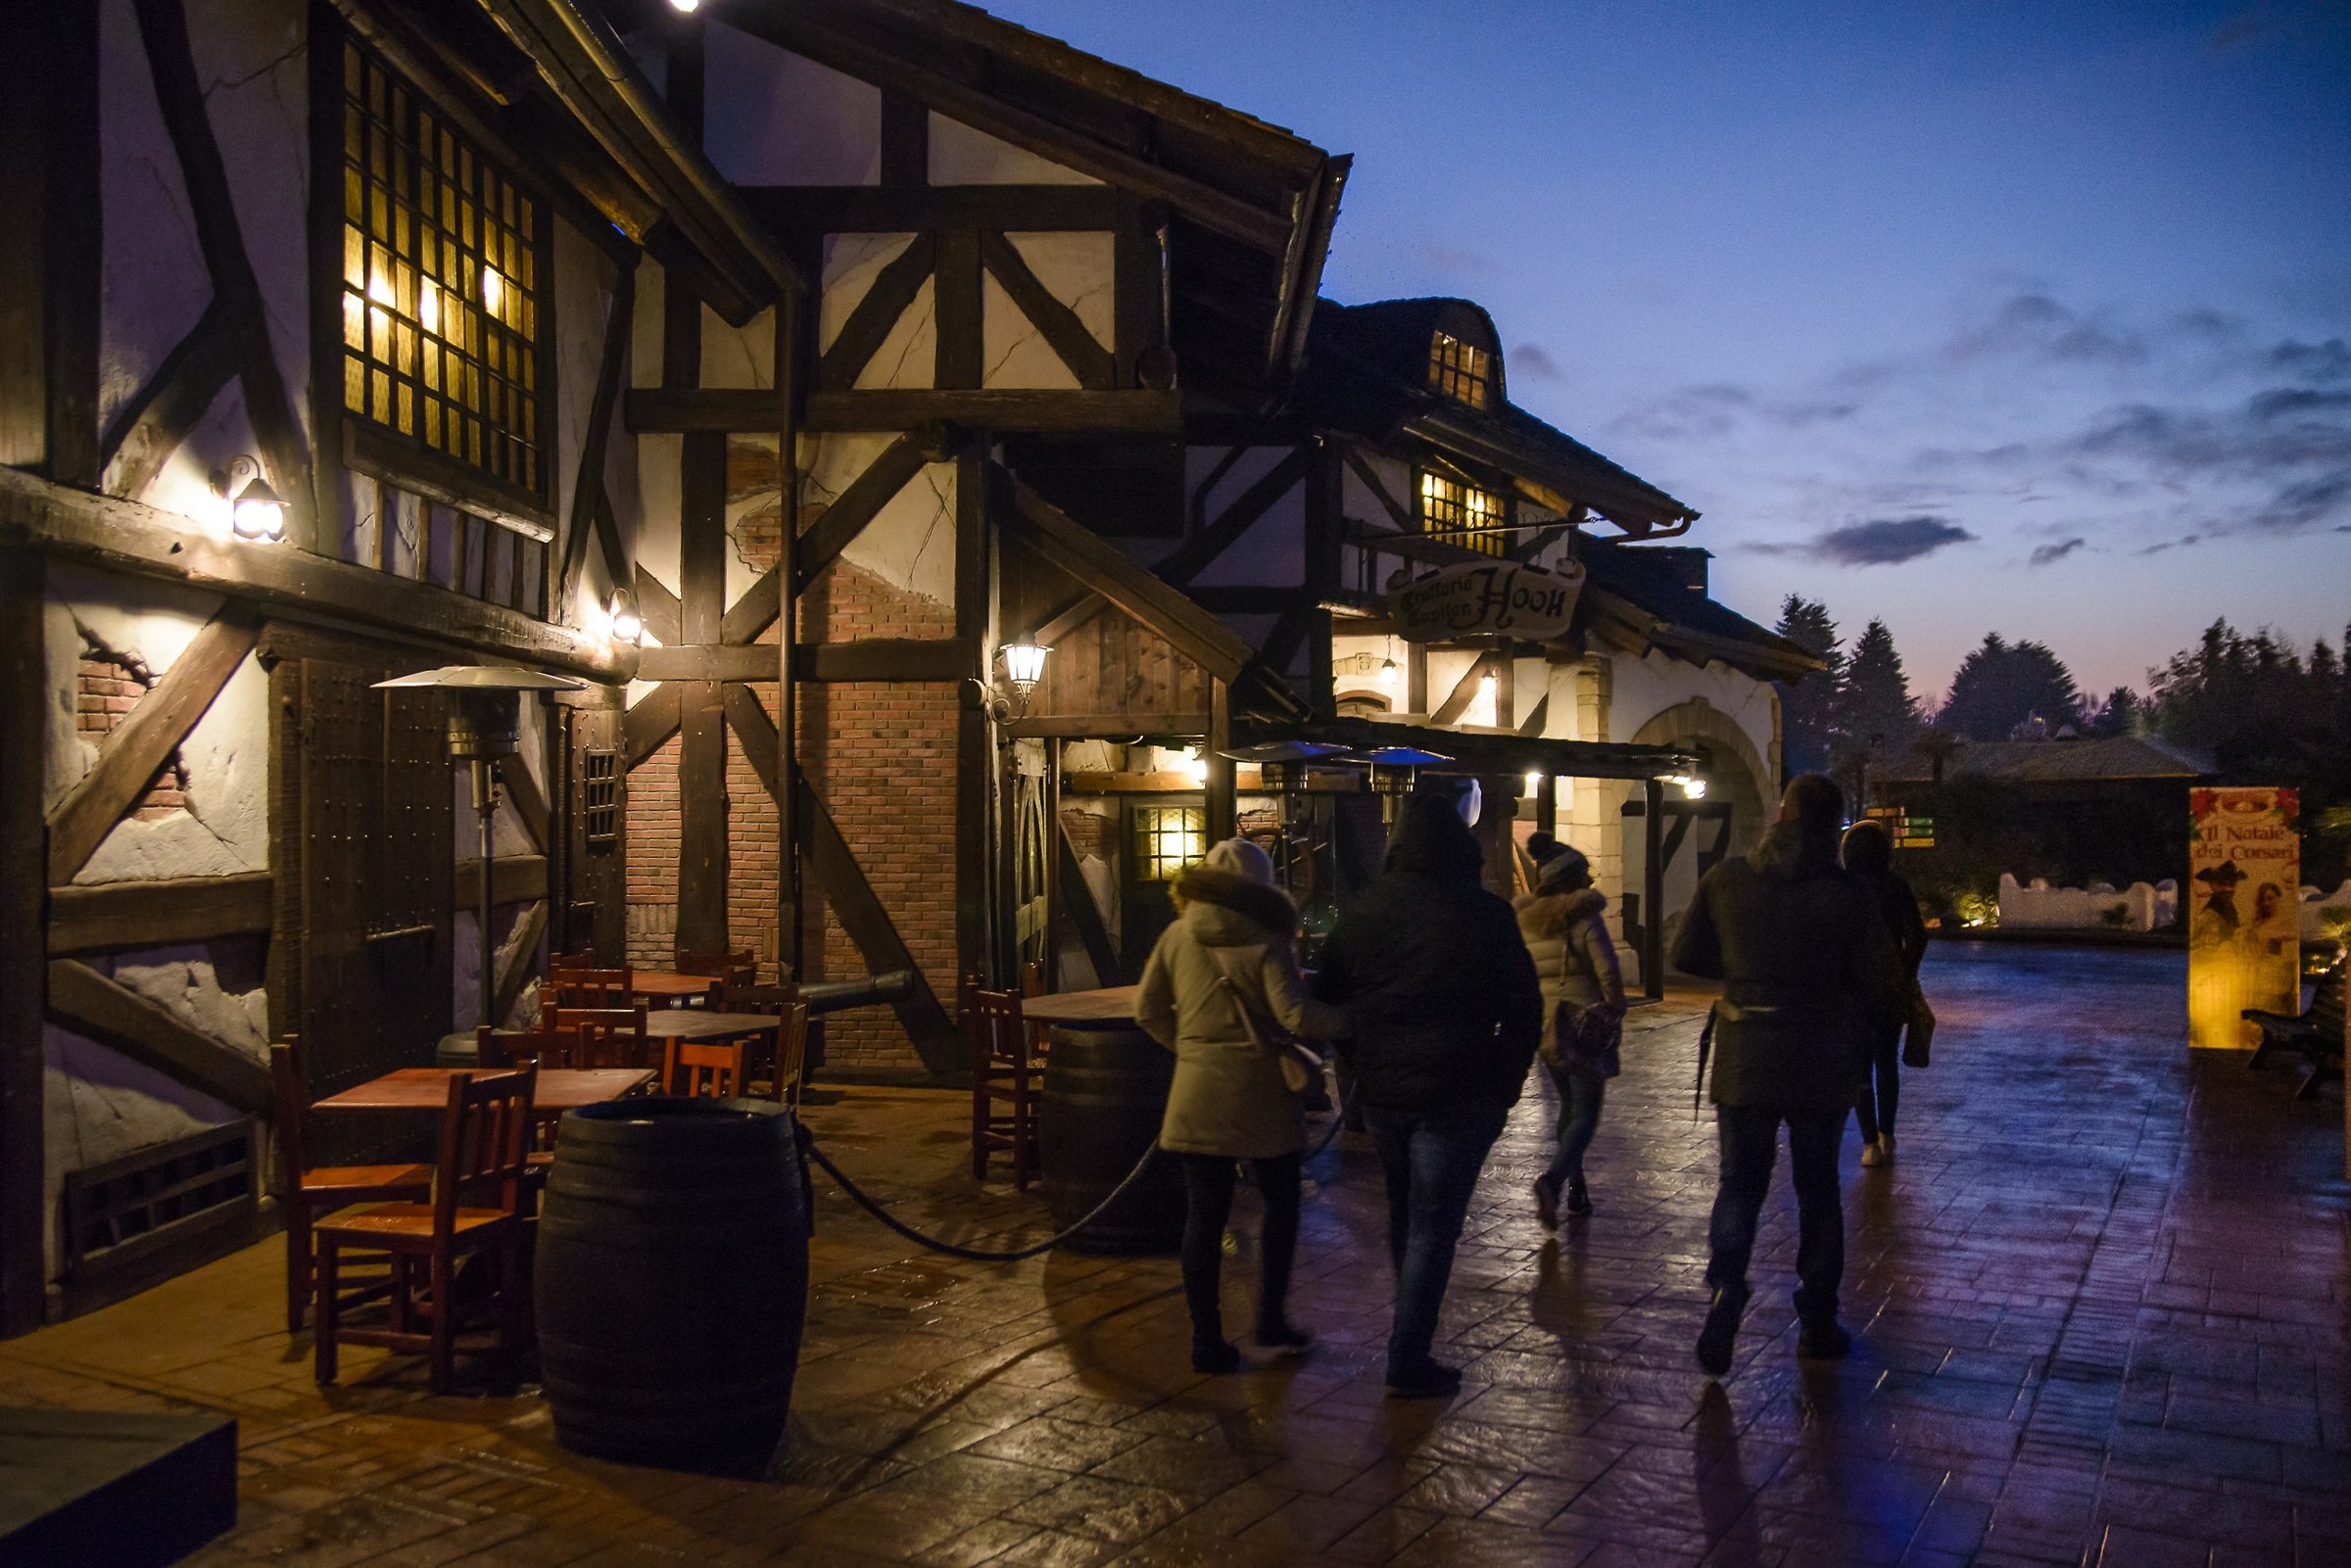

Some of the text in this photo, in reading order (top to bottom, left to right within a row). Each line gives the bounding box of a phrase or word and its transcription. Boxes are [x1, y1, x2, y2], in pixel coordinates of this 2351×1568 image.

[1401, 576, 1473, 612] Trattoria
[1449, 567, 1566, 629] Hook
[2205, 825, 2284, 841] Il Natale
[2196, 844, 2294, 861] dei Corsari
